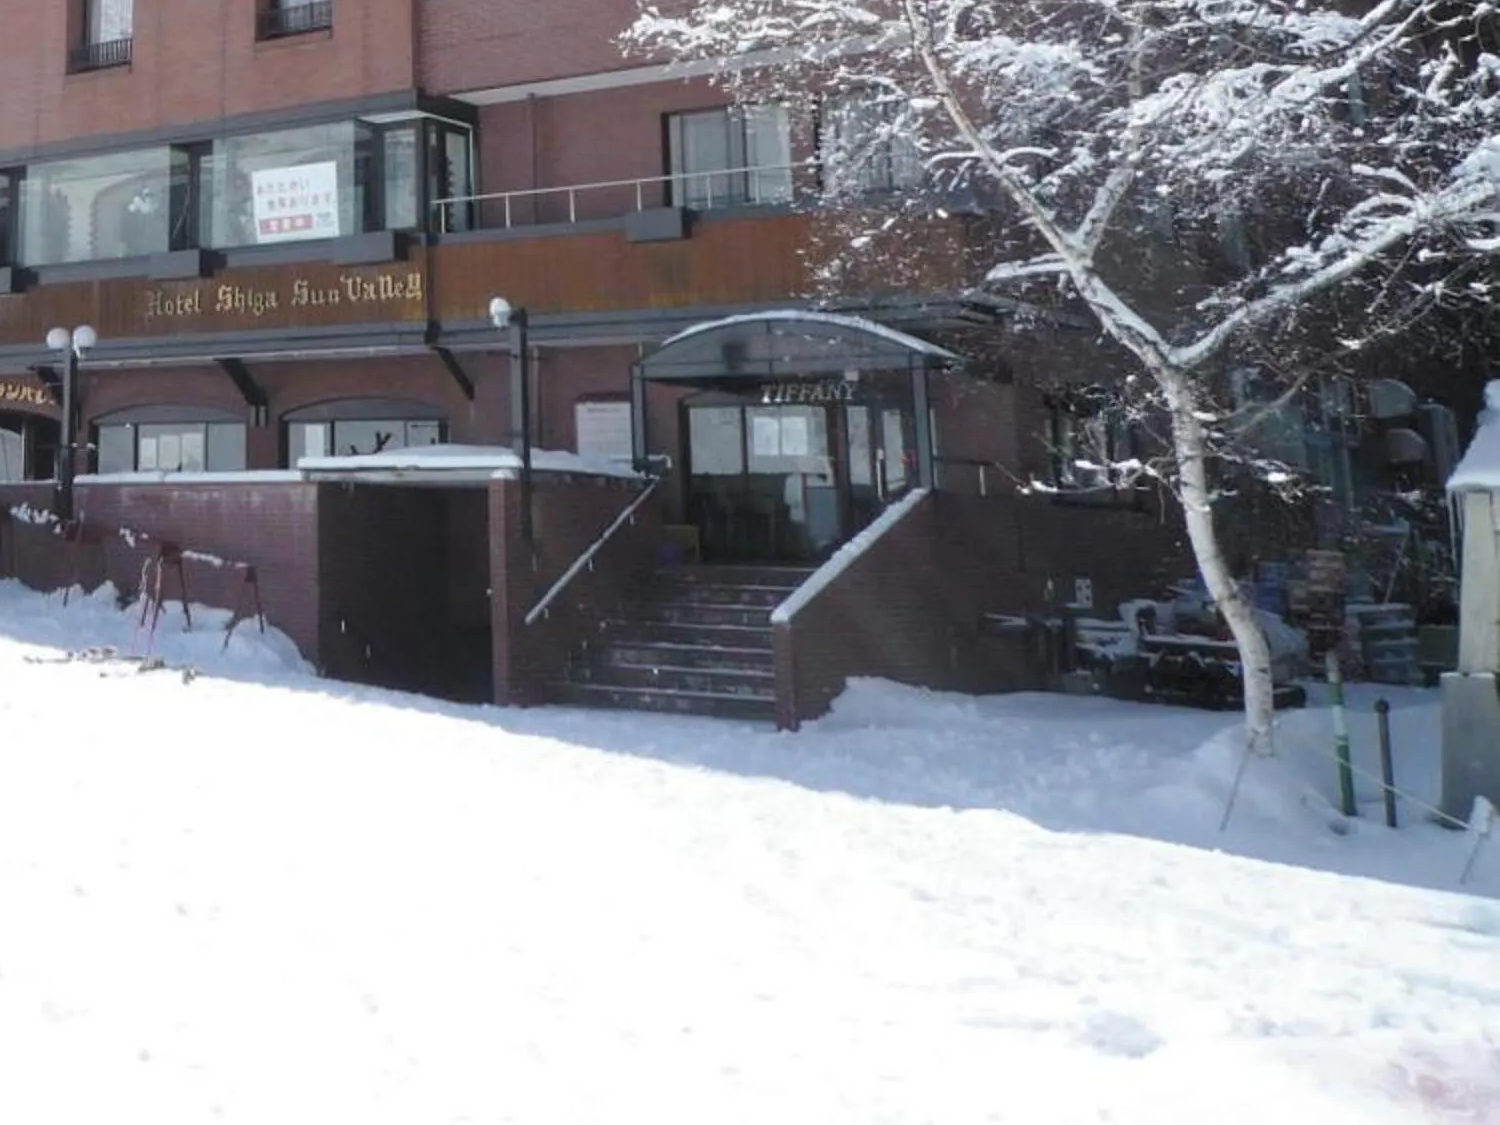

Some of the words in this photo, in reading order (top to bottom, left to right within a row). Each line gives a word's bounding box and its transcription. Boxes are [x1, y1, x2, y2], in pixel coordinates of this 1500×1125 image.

[145, 284, 201, 318] Hotel
[215, 283, 279, 316] Shiga
[290, 278, 340, 307] Sun
[760, 379, 858, 404] TIFFANY
